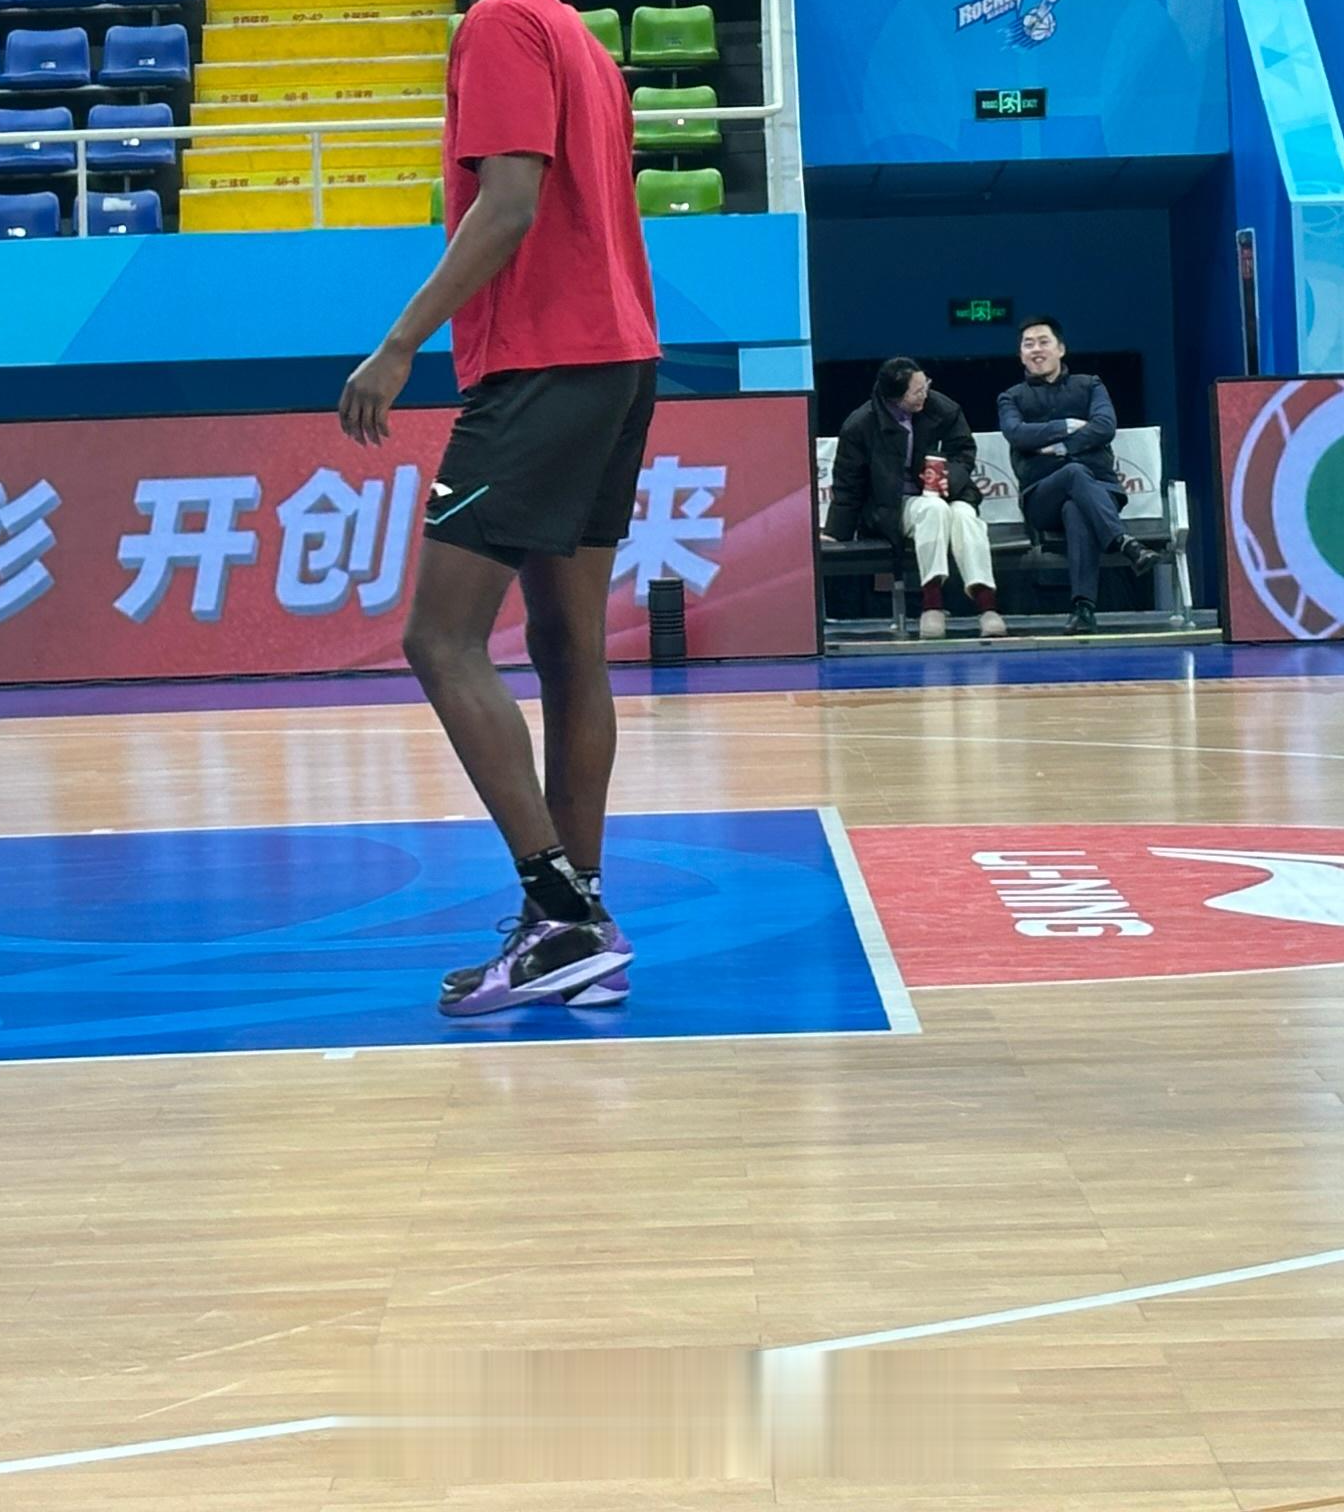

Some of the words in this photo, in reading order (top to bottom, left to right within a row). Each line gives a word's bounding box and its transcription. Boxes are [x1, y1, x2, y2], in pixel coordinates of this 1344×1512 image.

[112, 456, 728, 624] 开创来
[971, 850, 1155, 937] LI-NING
